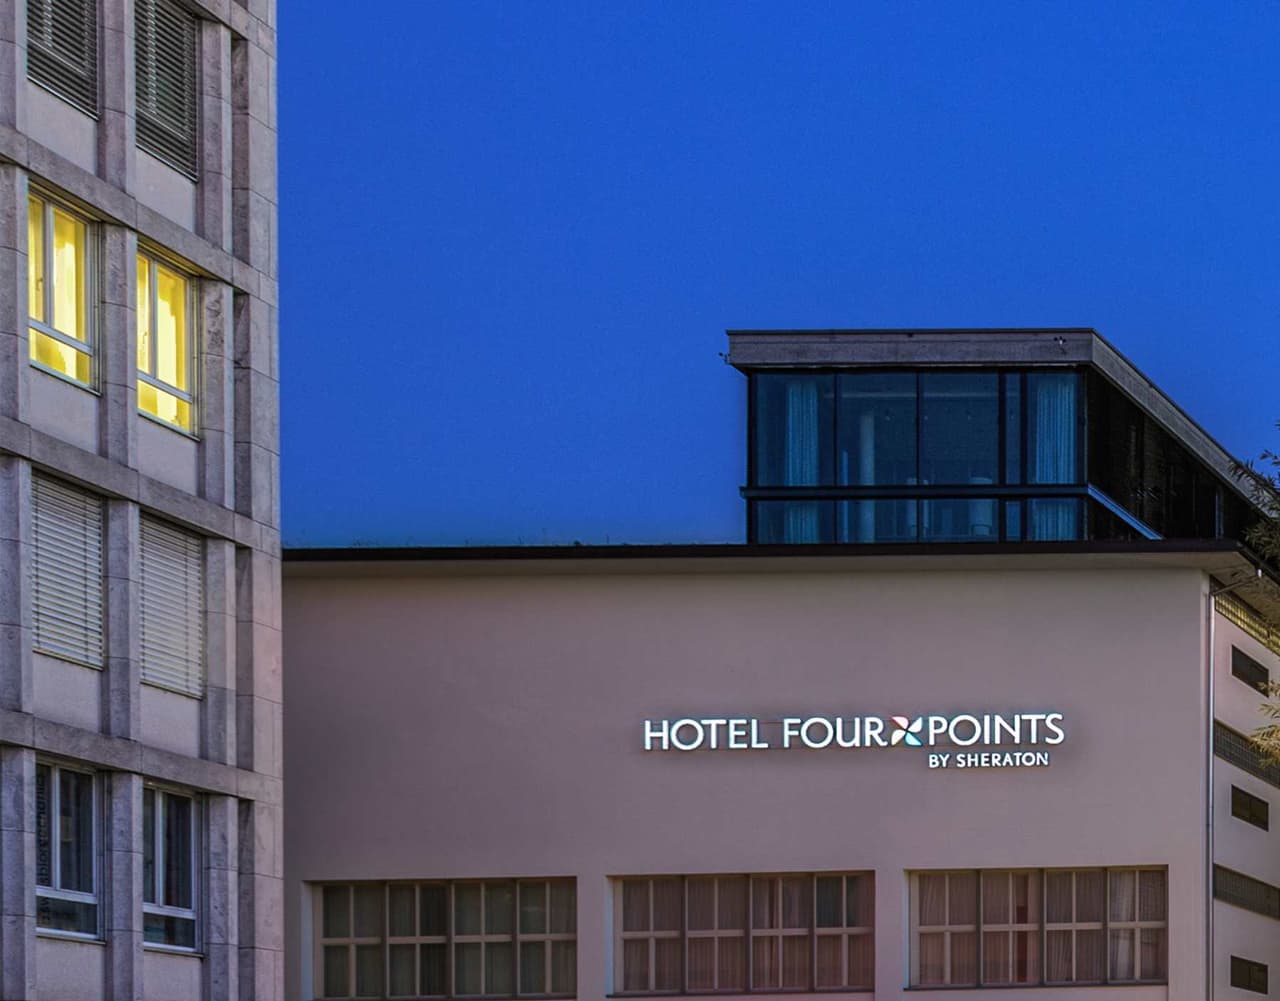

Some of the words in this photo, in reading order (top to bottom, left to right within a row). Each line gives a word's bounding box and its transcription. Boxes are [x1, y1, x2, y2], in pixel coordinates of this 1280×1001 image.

[643, 718, 769, 751] HOTEL
[782, 716, 888, 749] FOUR
[927, 713, 1066, 746] POINTS
[928, 753, 950, 769] BY
[956, 752, 1049, 768] SHERATON
